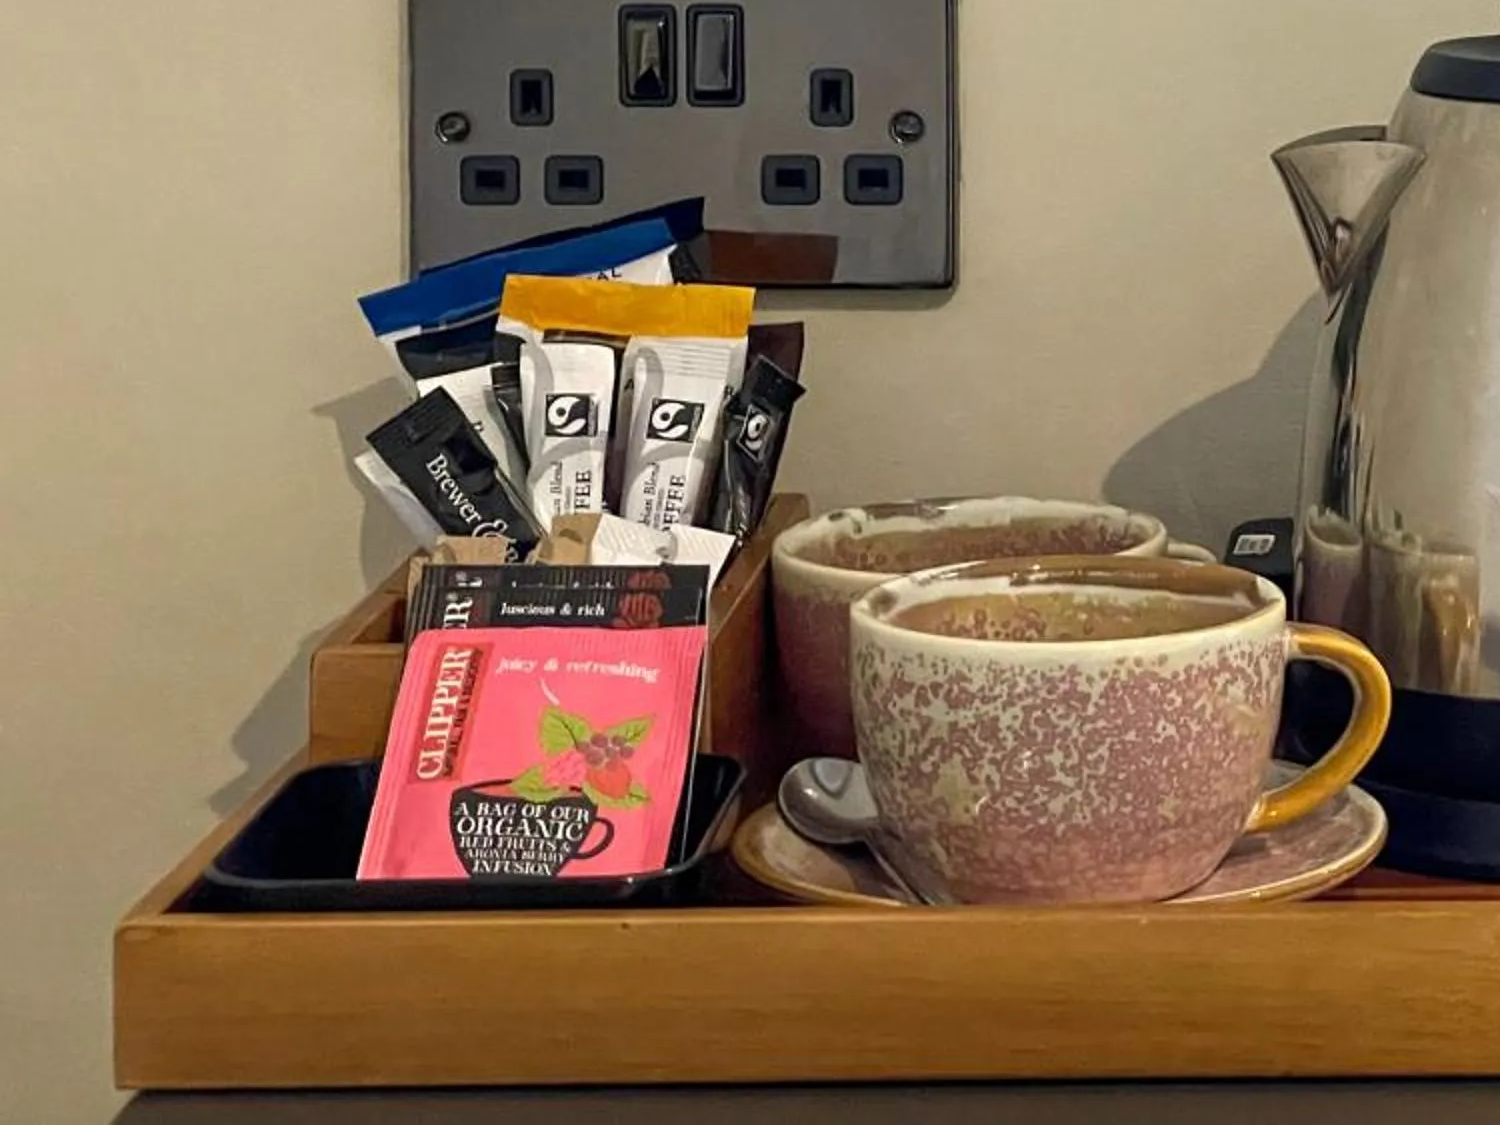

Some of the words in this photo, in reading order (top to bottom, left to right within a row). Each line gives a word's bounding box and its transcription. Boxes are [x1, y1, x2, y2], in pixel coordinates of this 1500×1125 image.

[425, 453, 482, 524] Brewer
[574, 469, 592, 515] FEE
[500, 602, 555, 616] luscious
[560, 603, 573, 616] &
[577, 603, 605, 617] rich
[544, 657, 559, 672] &
[566, 660, 661, 684] refreshing
[416, 646, 474, 780] CLIPPER
[454, 801, 469, 816] A
[477, 802, 517, 817] BAG
[521, 804, 547, 818] OF
[551, 806, 589, 824] OUR
[457, 816, 584, 842] ORGANIC
[459, 836, 494, 848] RED
[498, 837, 557, 852] FRUITS
[472, 859, 552, 876] INFUSION
